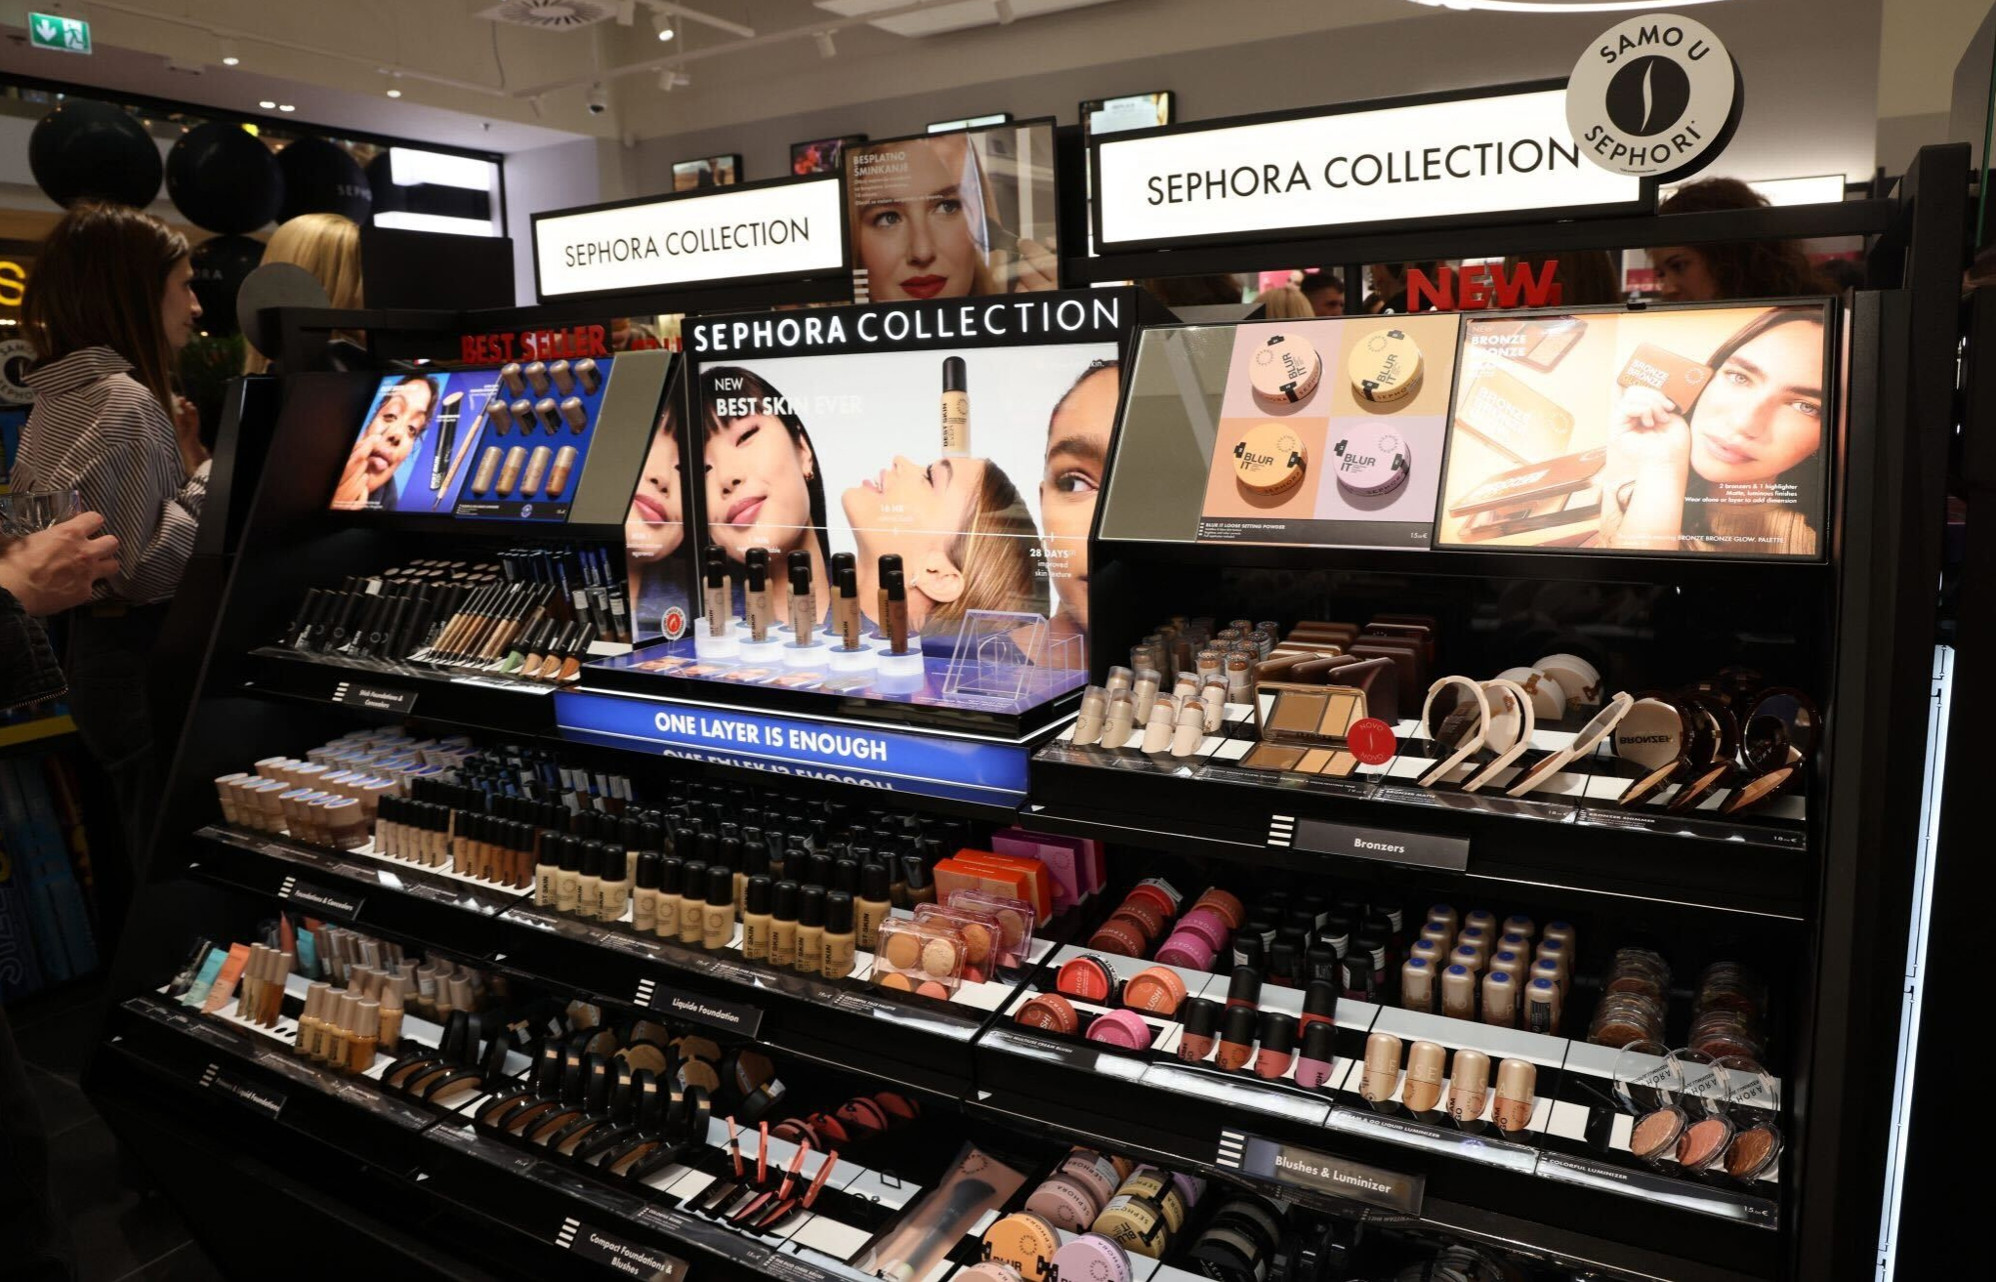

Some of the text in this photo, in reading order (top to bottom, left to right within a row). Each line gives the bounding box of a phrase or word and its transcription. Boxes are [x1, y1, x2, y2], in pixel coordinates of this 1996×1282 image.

[1600, 25, 1709, 63] SAMO U
[853, 152, 906, 165] BESPLATNO
[1147, 136, 1579, 205] SEPHORA COLLECTION
[565, 217, 809, 267] SEPHORA COLLECTION
[1406, 260, 1558, 312] NEW
[694, 297, 1119, 352] SEPHORA COLLECTION
[460, 324, 606, 364] BEST SELLER
[1471, 334, 1527, 345] BRONZE
[1472, 346, 1527, 357] RONZE
[1281, 352, 1298, 380] BLUR
[1376, 353, 1398, 383] BLUR
[715, 377, 743, 392] NEW
[716, 395, 863, 416] BEST SKIN EVER
[1240, 462, 1251, 470] IT
[1243, 453, 1275, 466] BLUR
[1340, 462, 1353, 472] IT
[1343, 453, 1376, 467] BLUR
[1725, 483, 1752, 491] bronzers
[1765, 484, 1798, 492] highlighter
[1030, 548, 1042, 557] 28
[1035, 569, 1048, 577] skin
[1359, 721, 1384, 732] NOVO
[654, 712, 887, 761] ONE LAYER IS ENOUGH
[1360, 751, 1385, 761] NOVO
[1385, 789, 1414, 797] BRONZER
[1354, 837, 1405, 853] Bronzers
[672, 998, 740, 1023] Liquide Foundation
[1380, 1120, 1403, 1130] LIQUID
[1403, 1125, 1440, 1138] LUMINIZER
[1275, 1155, 1392, 1194] Blushes & Luminizer
[1549, 1159, 1628, 1180] COLORFUL LUMINIZER
[589, 1232, 673, 1275] Compact Foundations &
[611, 1256, 640, 1276] Blushes
